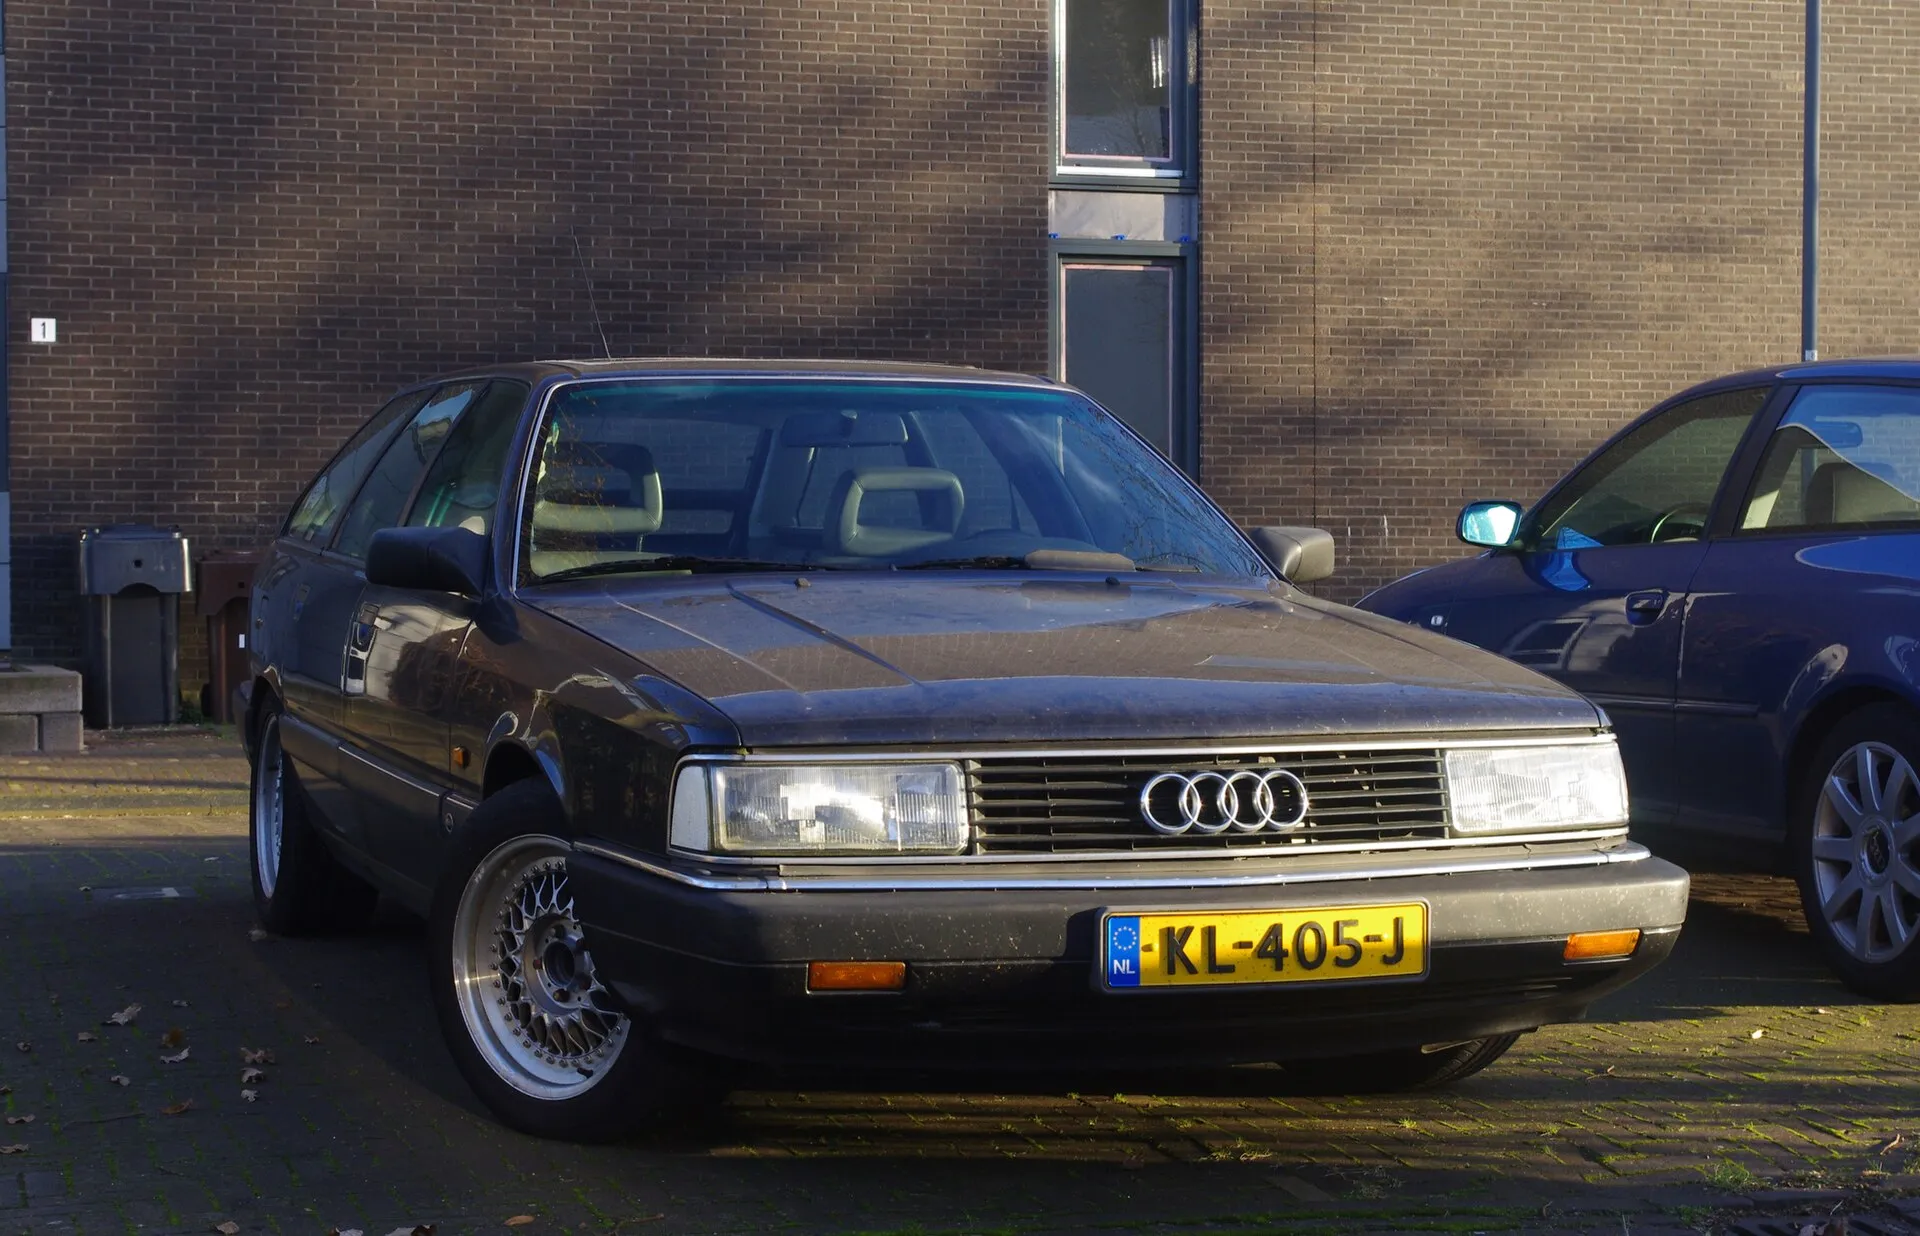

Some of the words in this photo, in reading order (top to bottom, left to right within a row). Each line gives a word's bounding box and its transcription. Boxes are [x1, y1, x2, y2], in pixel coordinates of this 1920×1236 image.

[40, 321, 46, 339] 1
[1166, 917, 1404, 975] KL-405-J
[1113, 959, 1136, 974] NL
